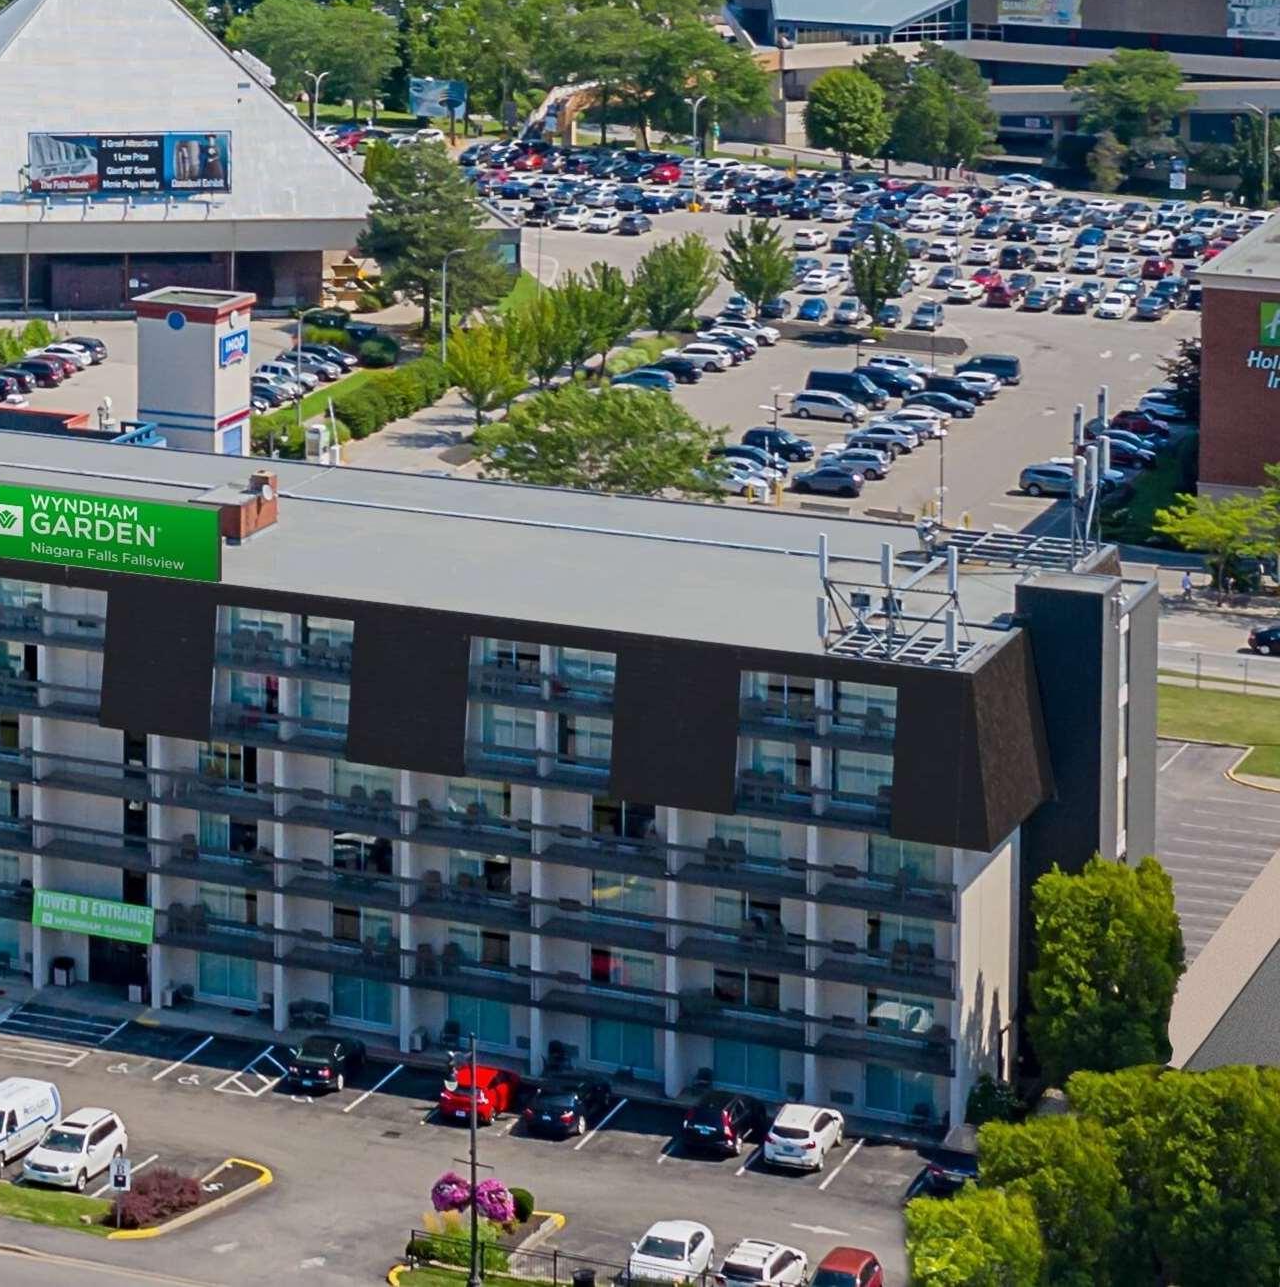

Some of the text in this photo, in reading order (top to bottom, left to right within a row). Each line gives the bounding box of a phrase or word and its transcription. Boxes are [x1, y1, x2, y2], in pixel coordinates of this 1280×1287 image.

[225, 334, 245, 353] IHOP
[1247, 350, 1280, 370] Hol
[30, 494, 138, 521] WYNDHAM
[30, 512, 156, 547] GARDEN
[31, 542, 185, 571] Niagara Falls Fallsview
[36, 894, 77, 913] TOWER
[91, 902, 152, 925] ENTRANCE
